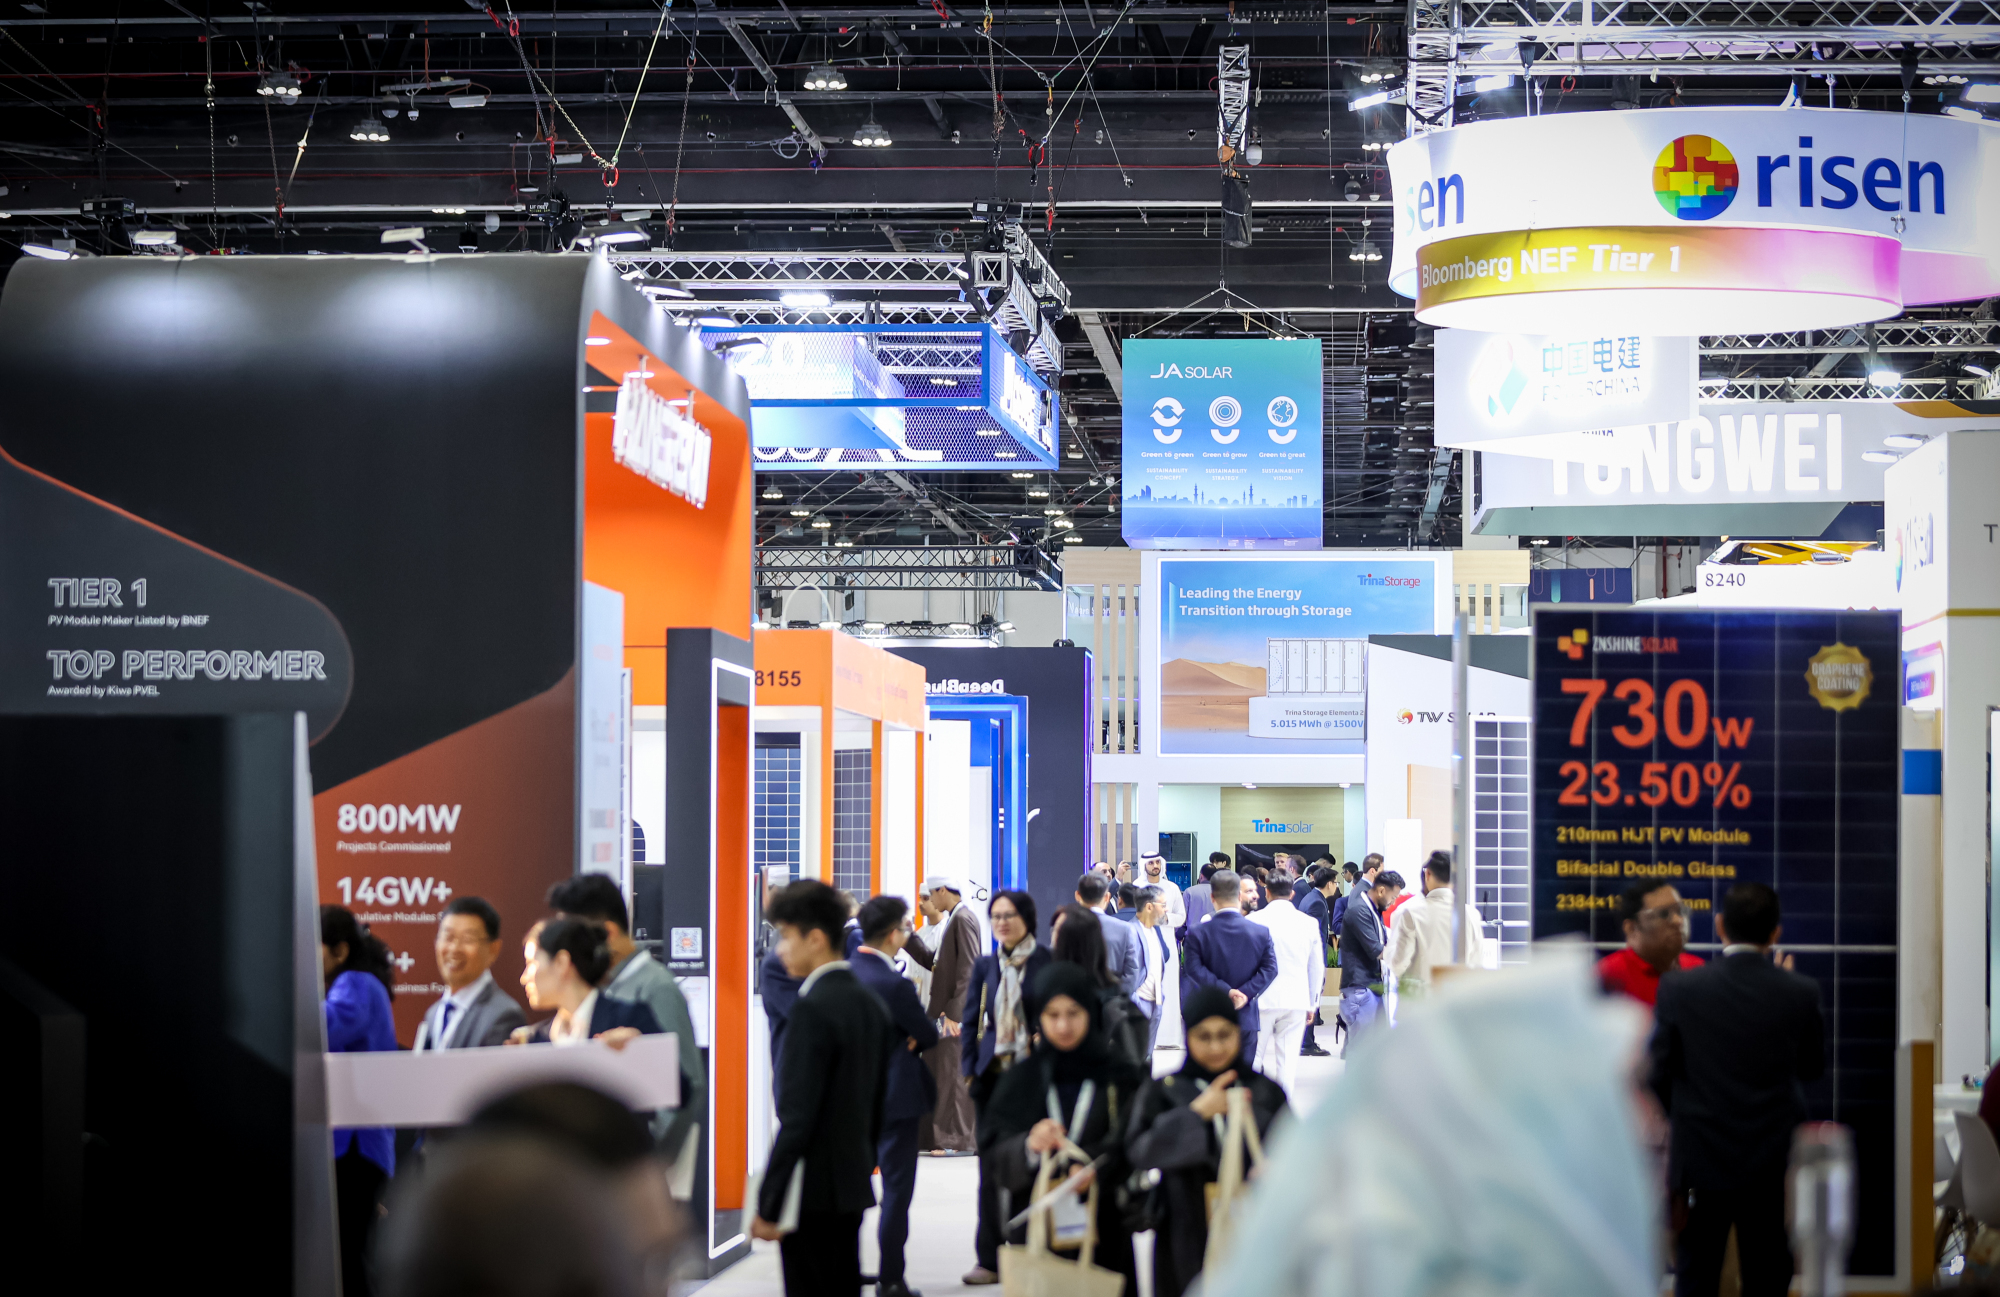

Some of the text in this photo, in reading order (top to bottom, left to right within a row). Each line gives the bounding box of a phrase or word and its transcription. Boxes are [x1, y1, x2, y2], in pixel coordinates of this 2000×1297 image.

[1756, 136, 1946, 215] risen
[1422, 245, 1680, 288] Bloomberg NEF Tier 1
[1542, 336, 1641, 377] 中国电建
[1150, 363, 1233, 379] JA SOLAR
[1288, 452, 1306, 460] great
[1705, 572, 1746, 588] 8240
[48, 578, 147, 608] TIER 1
[1180, 588, 1302, 601] Leading the Energy
[1179, 605, 1351, 618] Transition through Storage
[48, 614, 209, 628] PV Module Maker Listed by BNEF
[47, 650, 327, 680] TOP PERFORMER
[1811, 662, 1866, 677] GRAPHENE
[755, 671, 801, 686] 8155
[1817, 676, 1860, 690] COATING
[47, 685, 160, 699] Awarded by Kiwa PVEL
[1270, 720, 1297, 728] 5.015
[1299, 720, 1321, 728] MWh
[1324, 720, 1332, 729] @
[1558, 761, 1752, 808] 23.50%
[337, 804, 462, 833] 800MW
[1556, 826, 1751, 845] 210mm HJT PV Module
[337, 841, 451, 853] Projects Commissioned
[1556, 860, 1737, 878] Bifacial Double Glass
[337, 877, 452, 906] 14GW+
[394, 912, 436, 922] Modules
